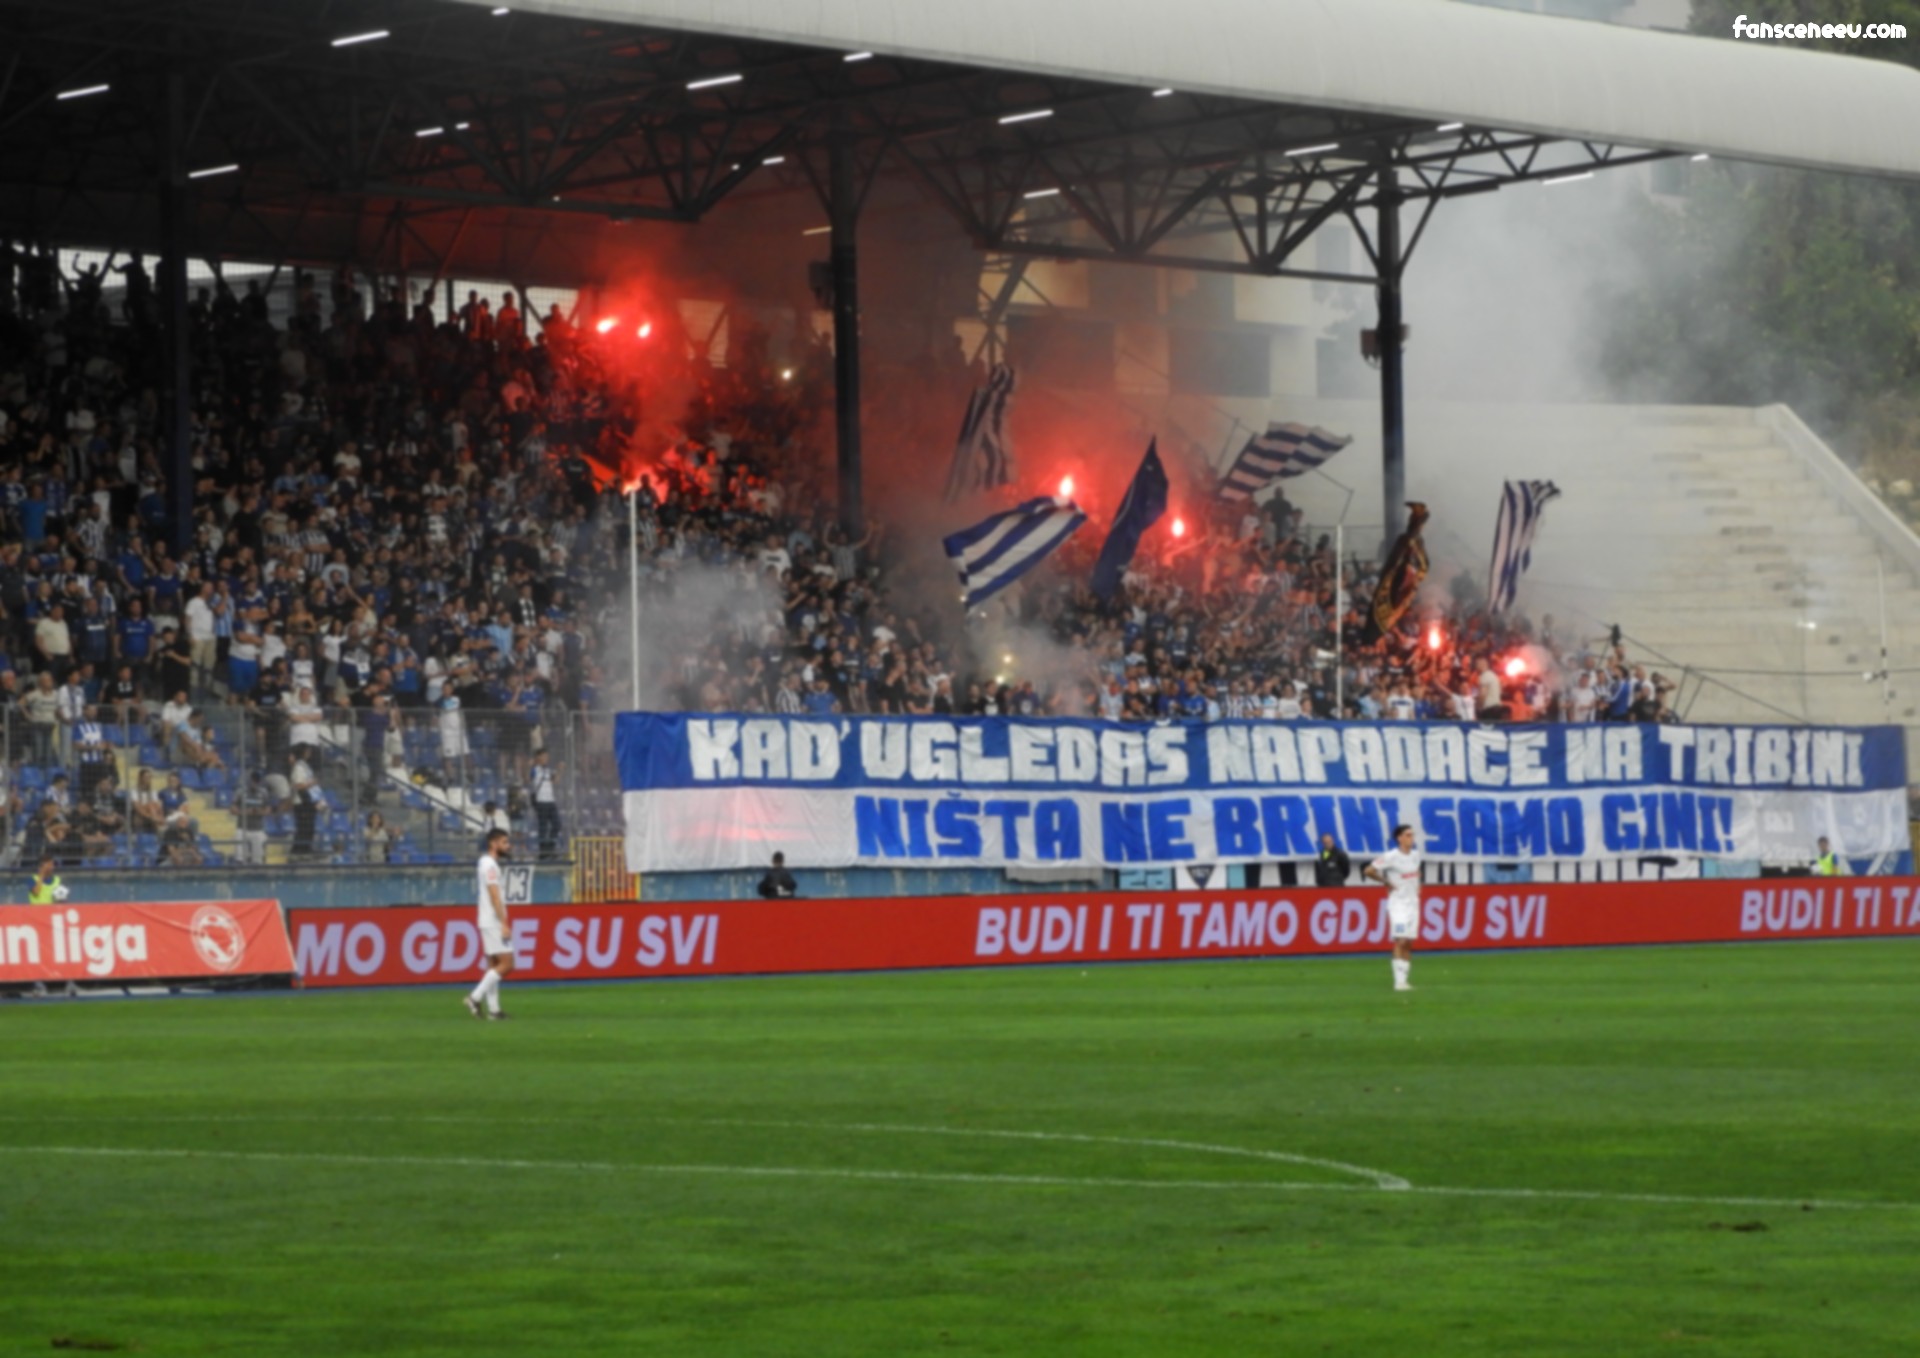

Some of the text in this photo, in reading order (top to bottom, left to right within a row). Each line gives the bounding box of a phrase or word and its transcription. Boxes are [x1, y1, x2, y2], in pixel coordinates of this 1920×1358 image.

[687, 718, 1863, 786] KAD' UGLEDAŠ NAPADAČE NA TRIBINI
[854, 790, 1734, 862] NIŠTA NE BRINI SAMO GINI!
[975, 894, 1547, 956] BUDI I TI TAMO GDJ SU SVI
[1740, 887, 1824, 931] BUDI
[1832, 887, 1843, 928] I
[1853, 886, 1881, 928] TI
[51, 908, 148, 976] liga
[401, 918, 540, 975] GDE
[551, 916, 624, 970] SU
[635, 914, 719, 968] SVI
